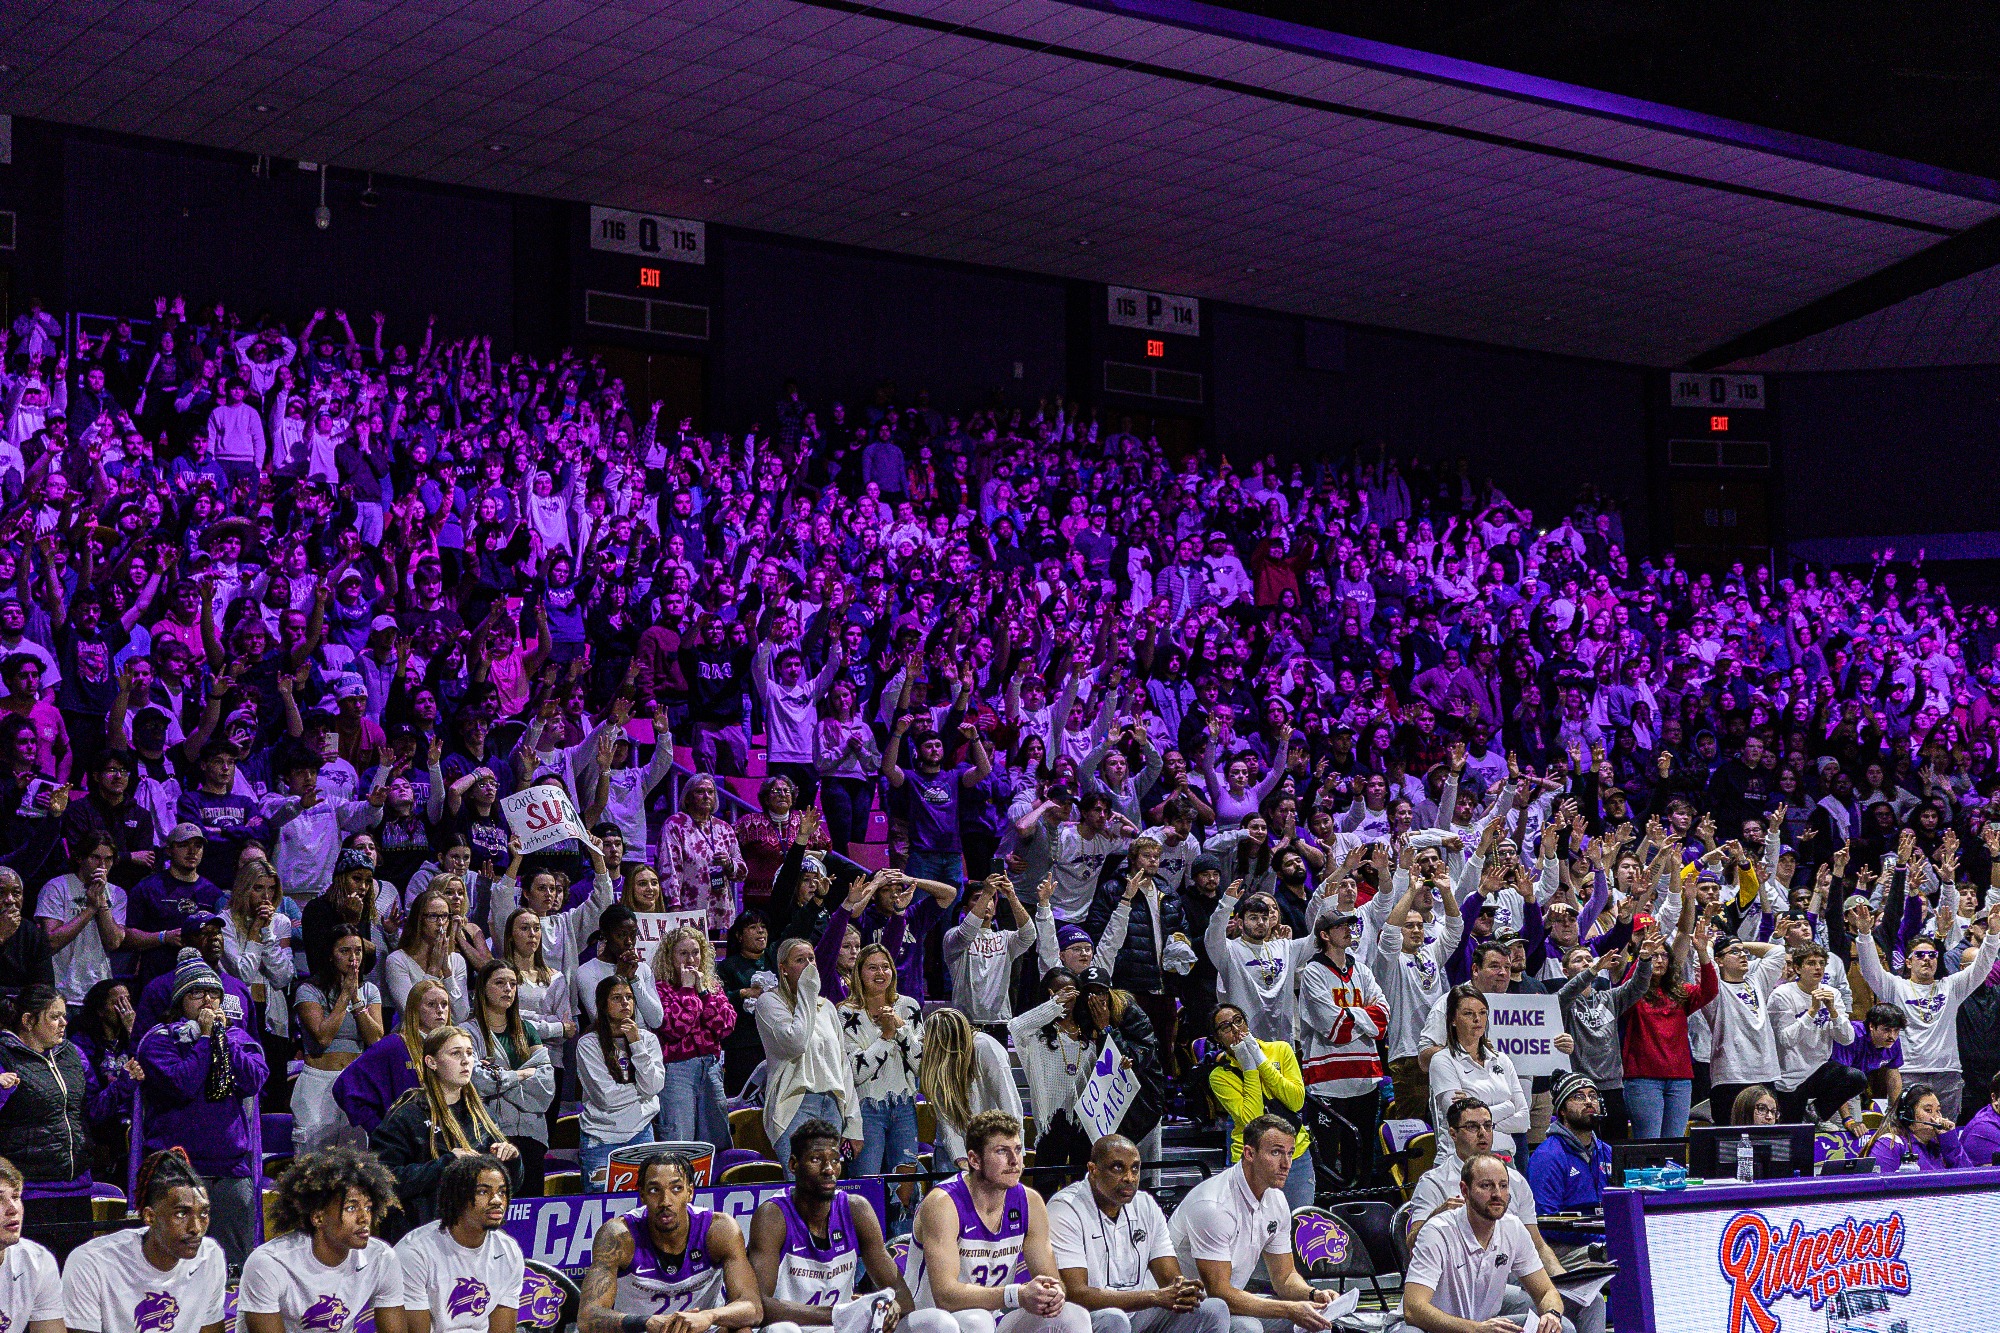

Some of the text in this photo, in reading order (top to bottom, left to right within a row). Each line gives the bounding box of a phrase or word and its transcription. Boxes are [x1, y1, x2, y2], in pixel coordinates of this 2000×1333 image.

[601, 218, 697, 253] 116 Q 115
[641, 268, 660, 287] EXIT
[1117, 295, 1193, 325] 115 P 114
[1147, 340, 1164, 357] EXIT
[1711, 417, 1729, 430] EXIT
[507, 791, 534, 812] Can't
[1088, 968, 1098, 979] 3
[1332, 988, 1363, 1007] KA
[1493, 1010, 1545, 1026] MAKE
[1497, 1038, 1550, 1054] NOISE
[1082, 1080, 1100, 1118] GO
[507, 1203, 531, 1220] THE
[789, 1266, 824, 1280] WESTERN
[1721, 1213, 1904, 1333] Ridgecrest
[1806, 1262, 1908, 1302] TOWING
